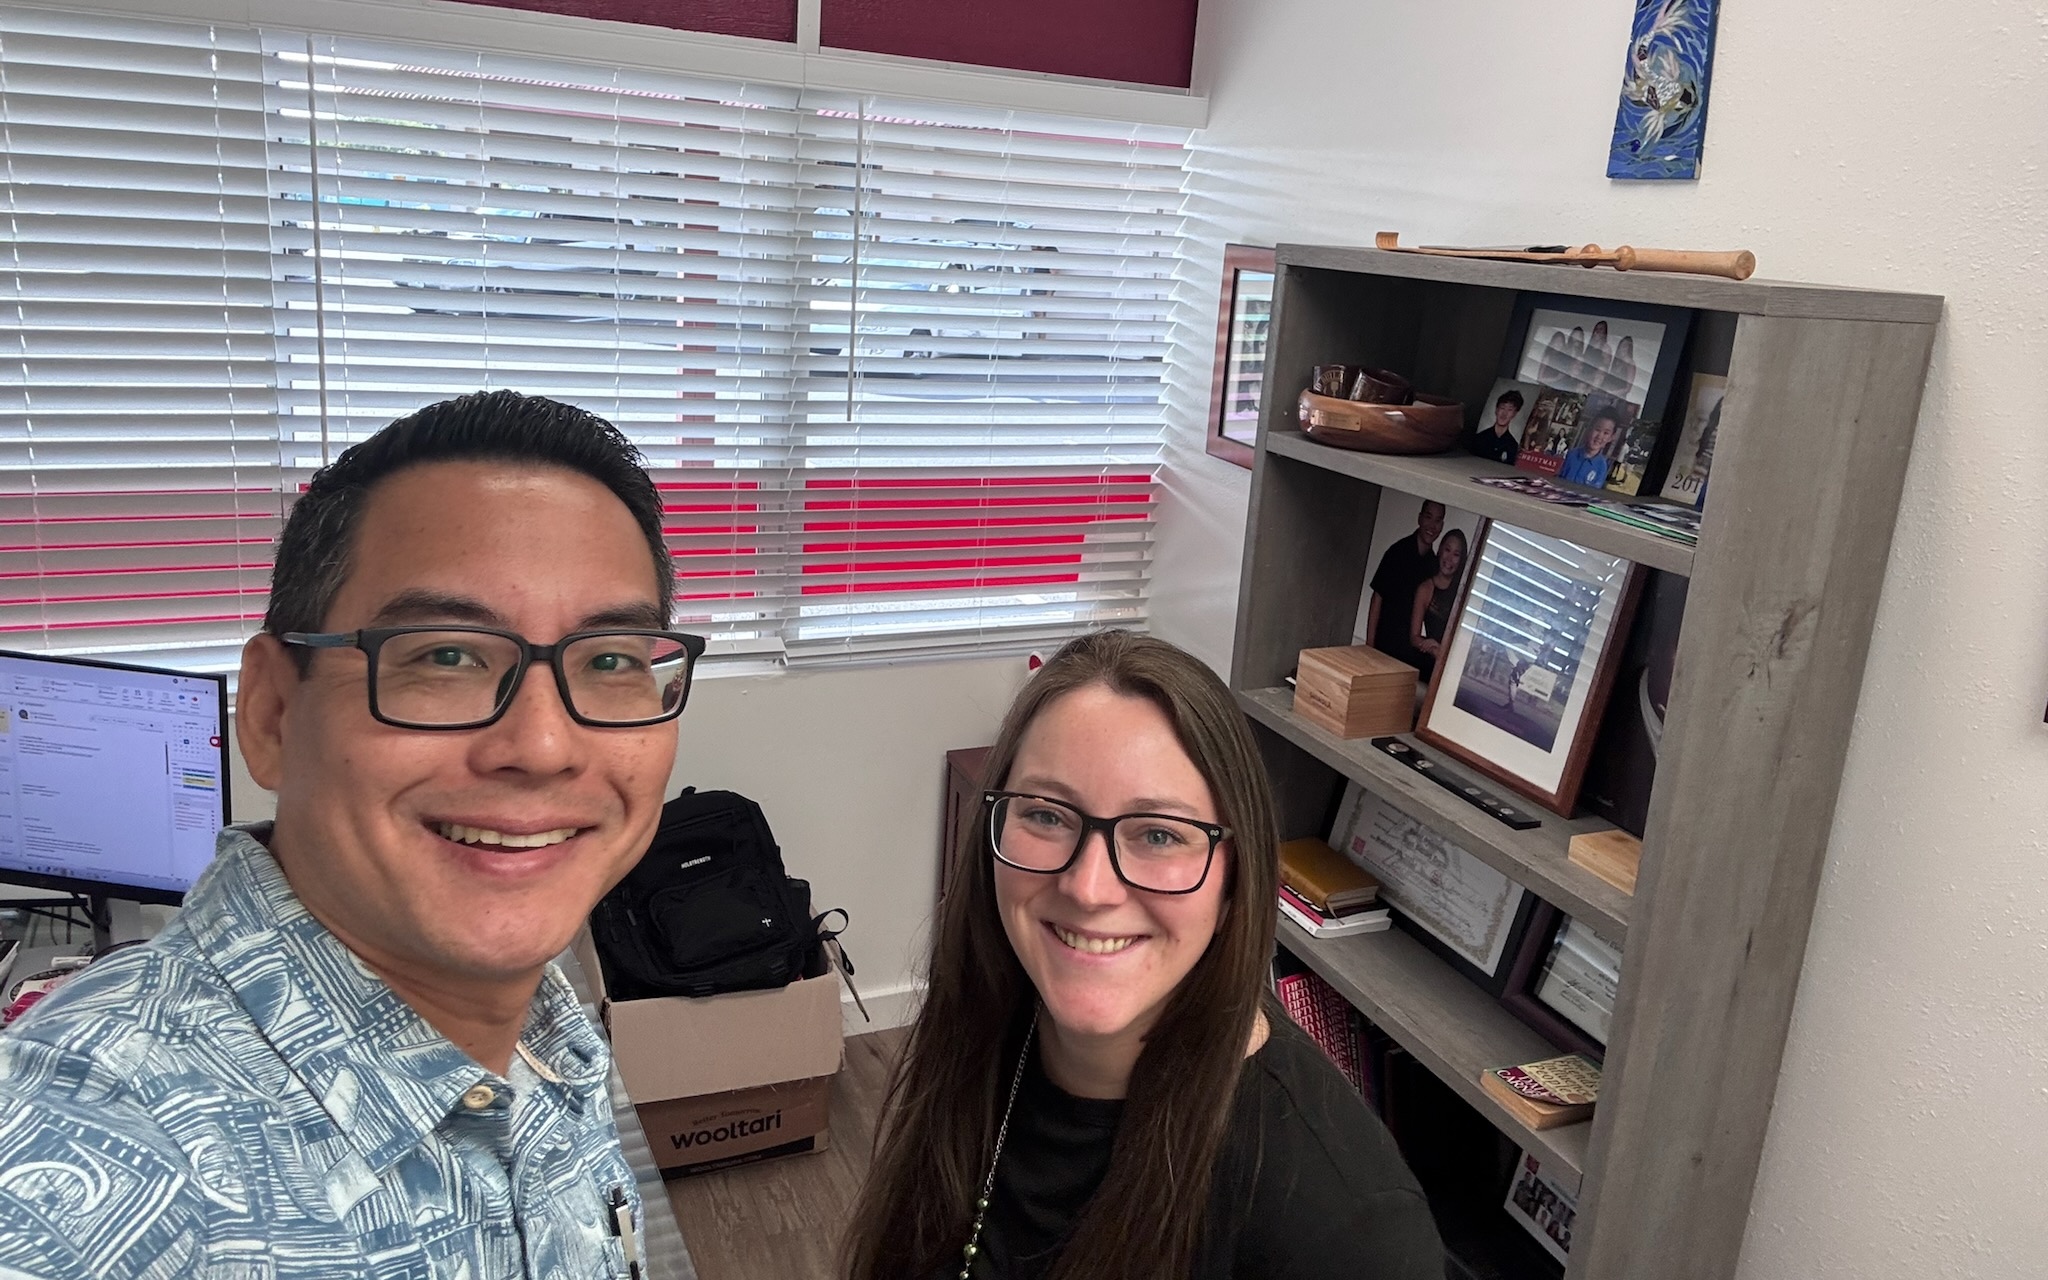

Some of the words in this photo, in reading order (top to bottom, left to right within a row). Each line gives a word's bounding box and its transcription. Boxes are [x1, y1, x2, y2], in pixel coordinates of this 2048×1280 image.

[1671, 474, 1703, 493] 201
[1528, 1064, 1572, 1093] People
[670, 1109, 782, 1150] wooltari
